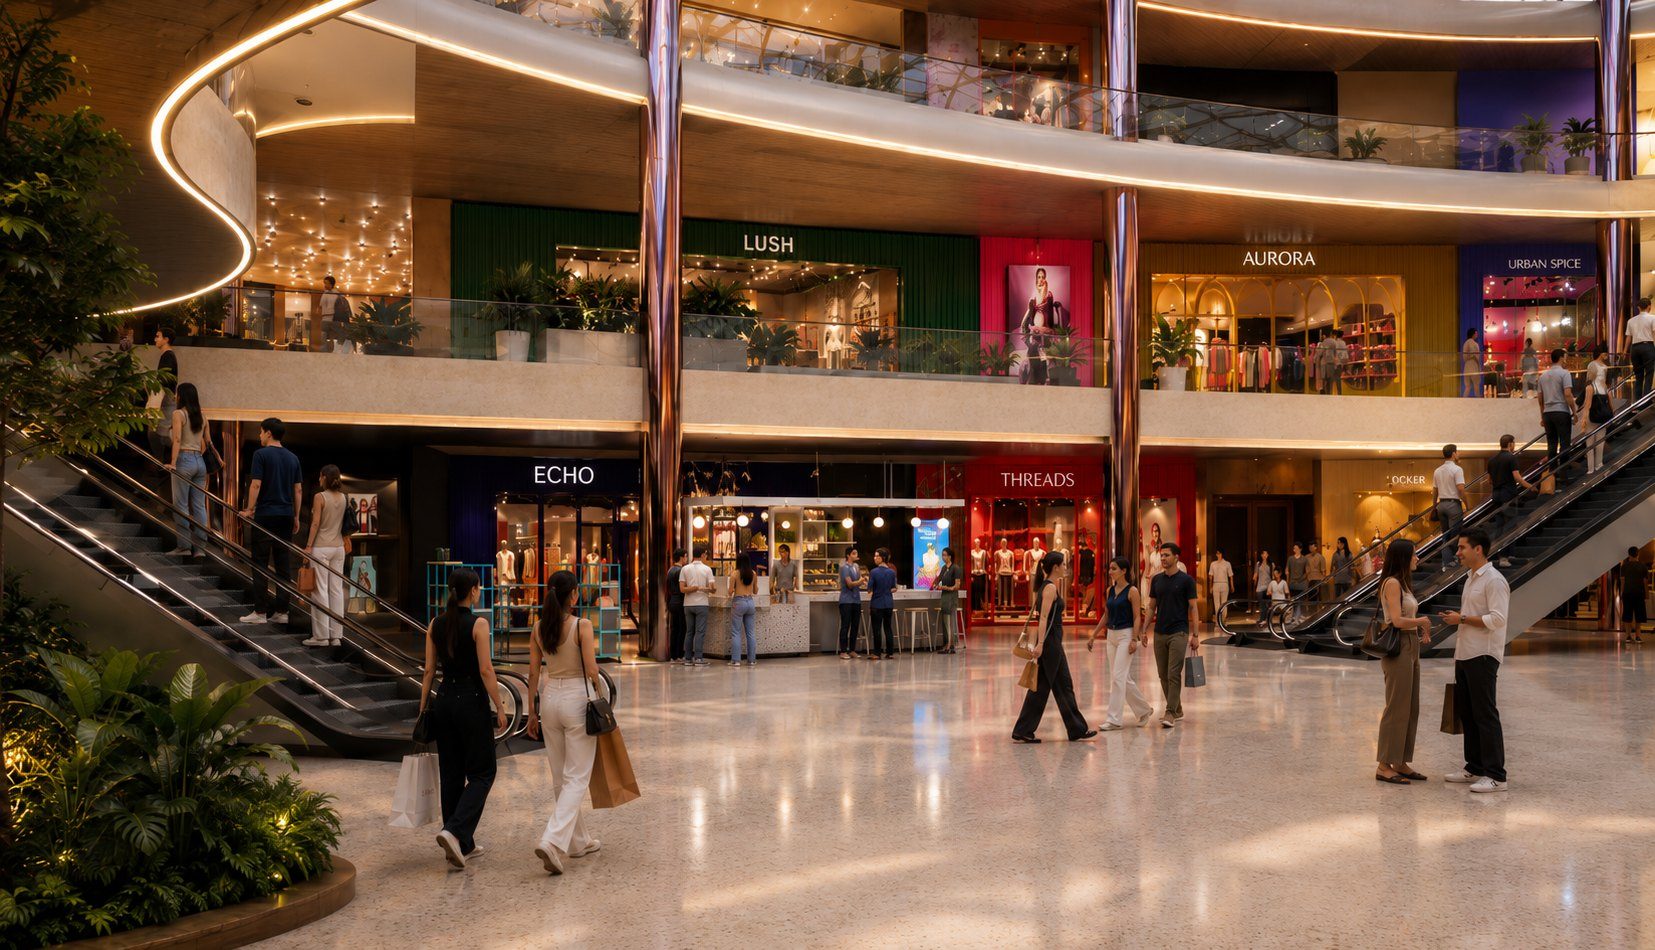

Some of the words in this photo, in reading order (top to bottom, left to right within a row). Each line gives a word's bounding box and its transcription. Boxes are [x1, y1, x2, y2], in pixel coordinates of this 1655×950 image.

[744, 234, 794, 254] LUSH
[1242, 251, 1316, 266] AURORA
[1508, 258, 1547, 270] URBAN
[1550, 258, 1581, 269] SPICE
[534, 465, 595, 485] ECHO
[1000, 472, 1075, 487] THREADS
[1386, 475, 1426, 485] OCKER
